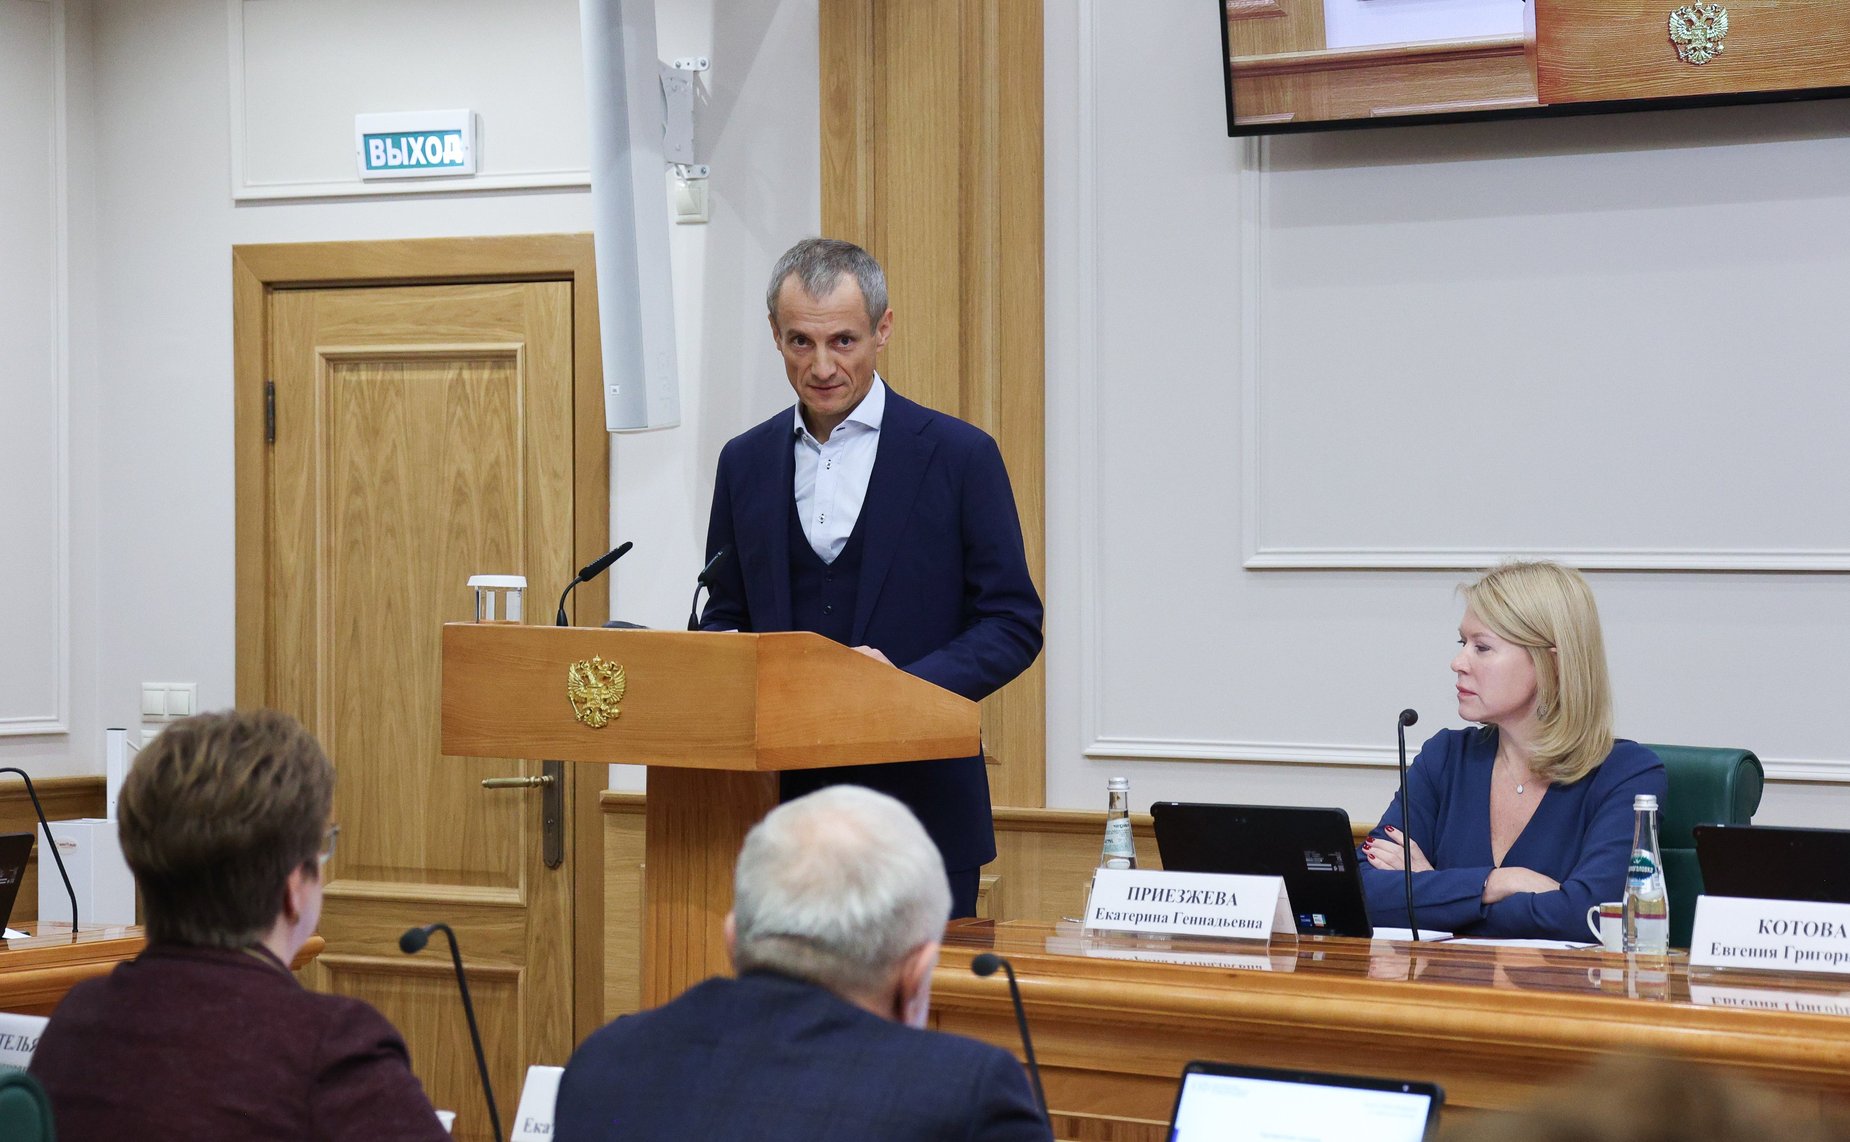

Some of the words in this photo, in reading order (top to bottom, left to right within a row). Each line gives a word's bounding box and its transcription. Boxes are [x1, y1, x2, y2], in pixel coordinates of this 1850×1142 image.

[368, 134, 464, 167] ВЫХОД
[1127, 886, 1239, 907] ПРИЕЗЖЕВА
[1095, 907, 1169, 926] Екатерина
[1173, 911, 1263, 929] Геннадьевна
[1758, 919, 1848, 939] КОТОВА
[1710, 942, 1778, 959] Евгения
[523, 1117, 554, 1135] Ека
